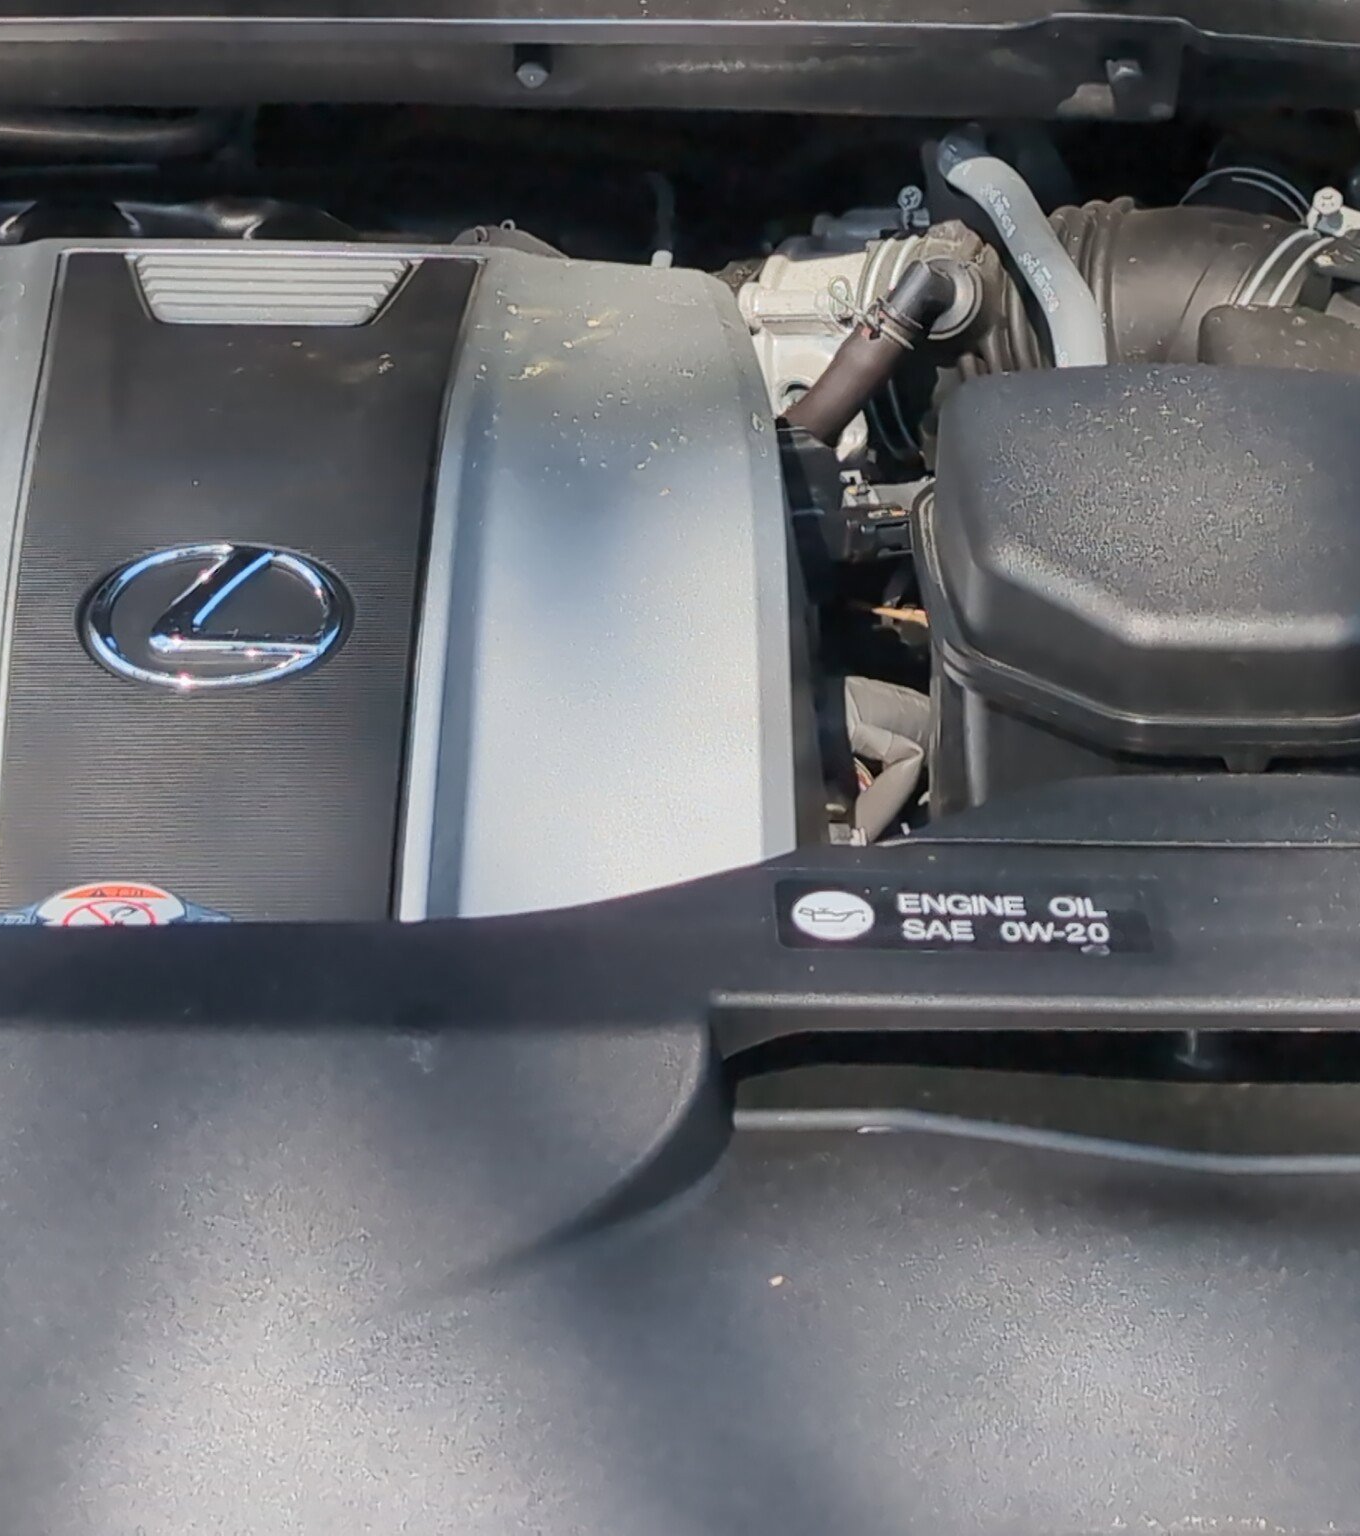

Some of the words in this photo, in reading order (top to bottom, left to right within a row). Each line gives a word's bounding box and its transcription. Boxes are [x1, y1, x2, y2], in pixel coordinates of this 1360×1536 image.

[896, 892, 1027, 916] ENGINE
[1048, 896, 1109, 919] OIL
[901, 919, 976, 943] SAE
[1000, 922, 1110, 944] 0W-20
